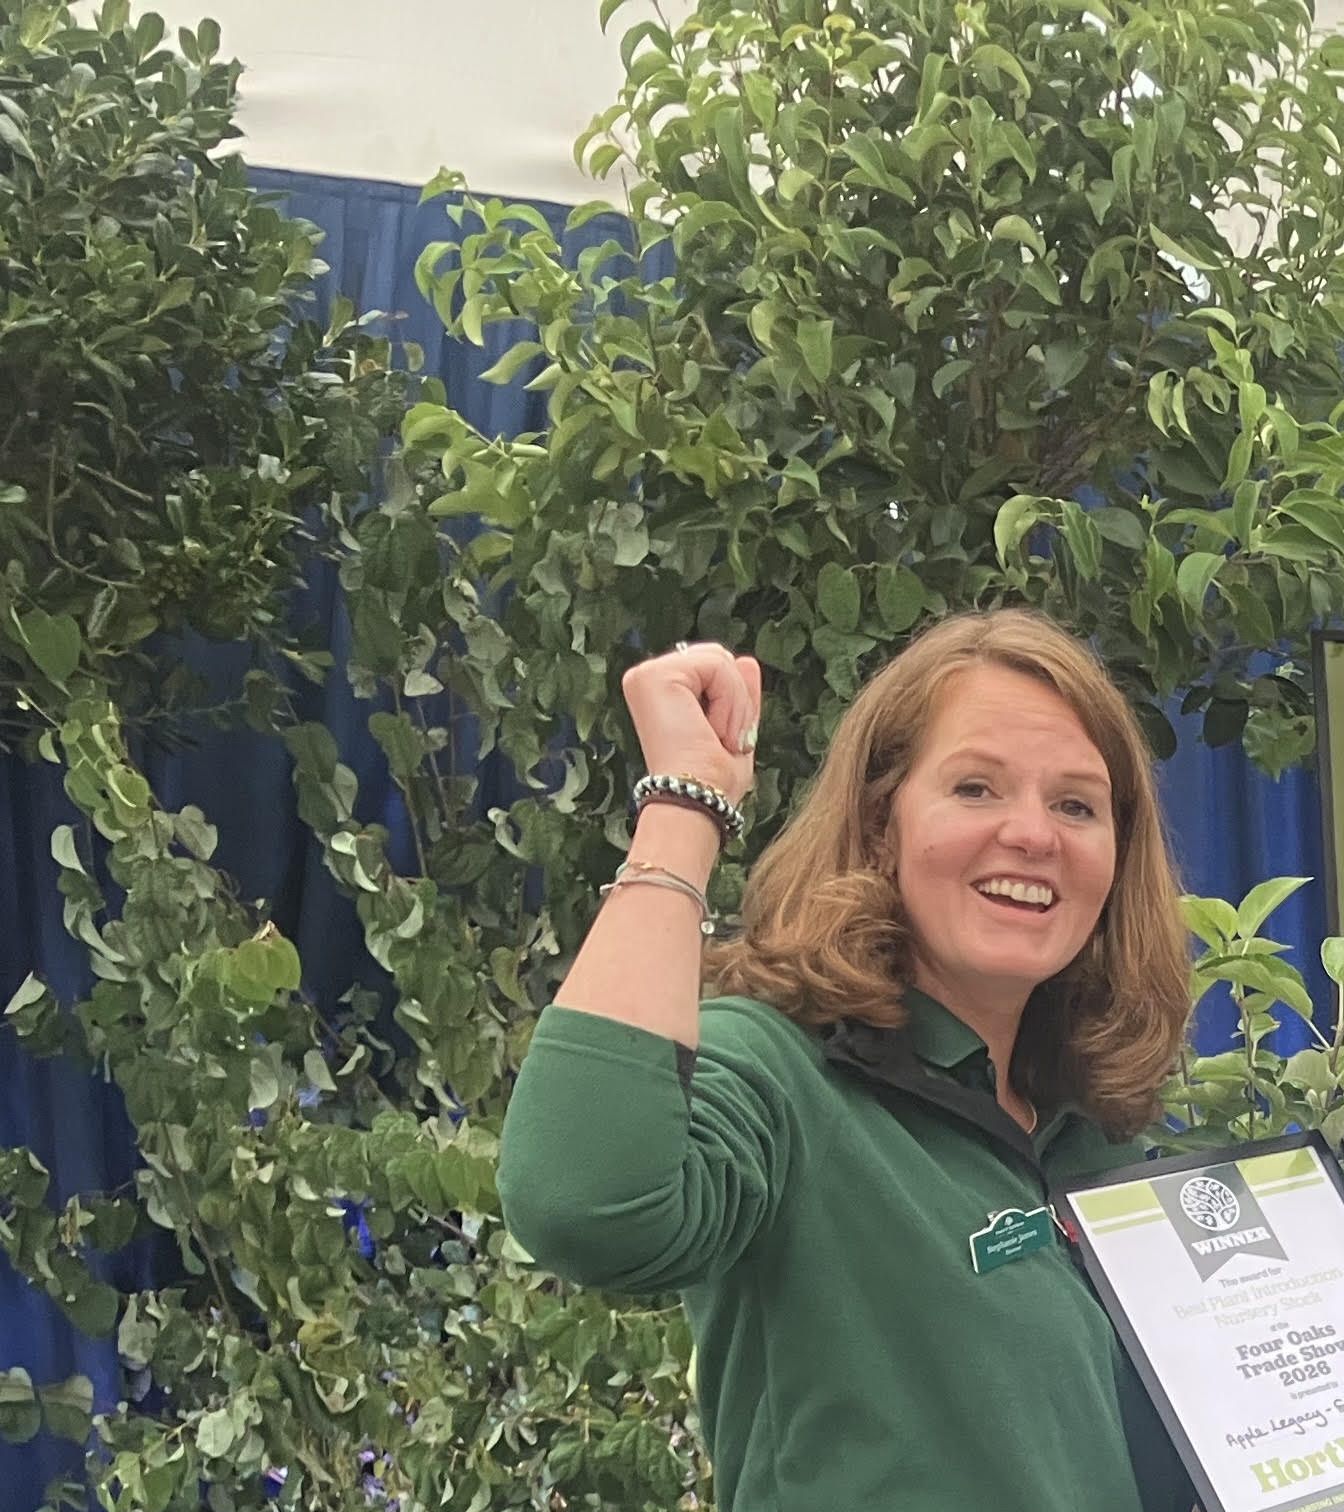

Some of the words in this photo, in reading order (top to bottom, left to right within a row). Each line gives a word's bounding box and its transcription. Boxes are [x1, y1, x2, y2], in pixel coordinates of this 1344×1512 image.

[1189, 1225, 1272, 1257] WINNER
[1234, 1335, 1286, 1361] Four
[1284, 1320, 1337, 1347] Oaks
[1235, 1350, 1300, 1380] Trade
[1277, 1359, 1333, 1387] 2026
[1222, 1421, 1272, 1453] Apple
[1267, 1404, 1330, 1442] Legacy
